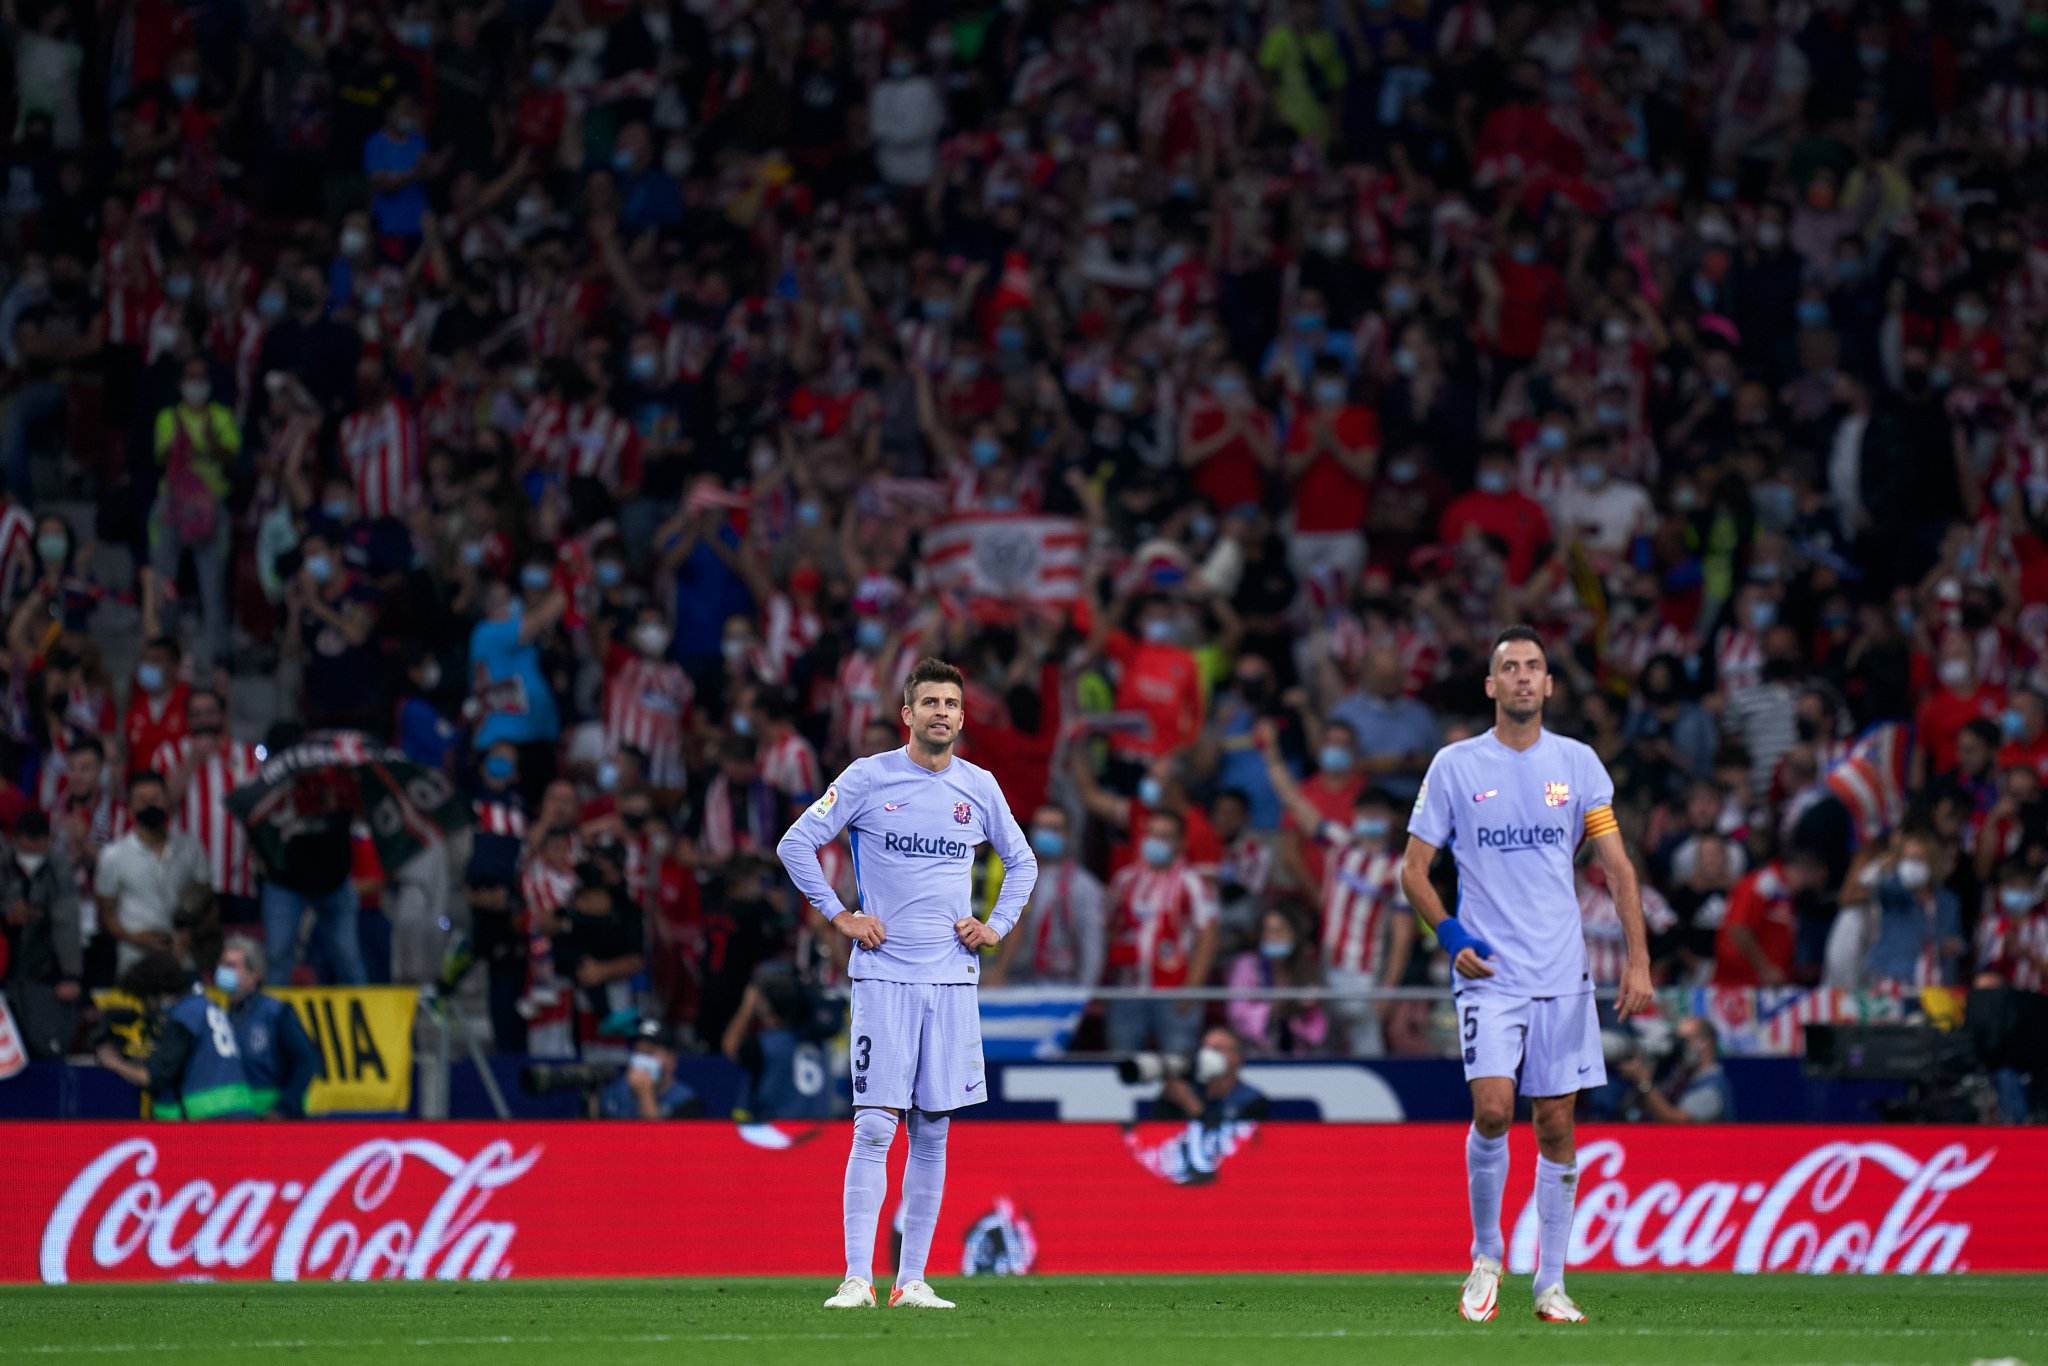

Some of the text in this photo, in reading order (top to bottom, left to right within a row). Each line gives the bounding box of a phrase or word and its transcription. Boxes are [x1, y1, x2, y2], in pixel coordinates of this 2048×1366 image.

[885, 832, 967, 858] Rakuten
[1477, 823, 1565, 848] Rakuten
[206, 1006, 238, 1058] 8
[1464, 1006, 1479, 1042] 5
[793, 1044, 824, 1096] 6
[855, 1035, 872, 1072] 3
